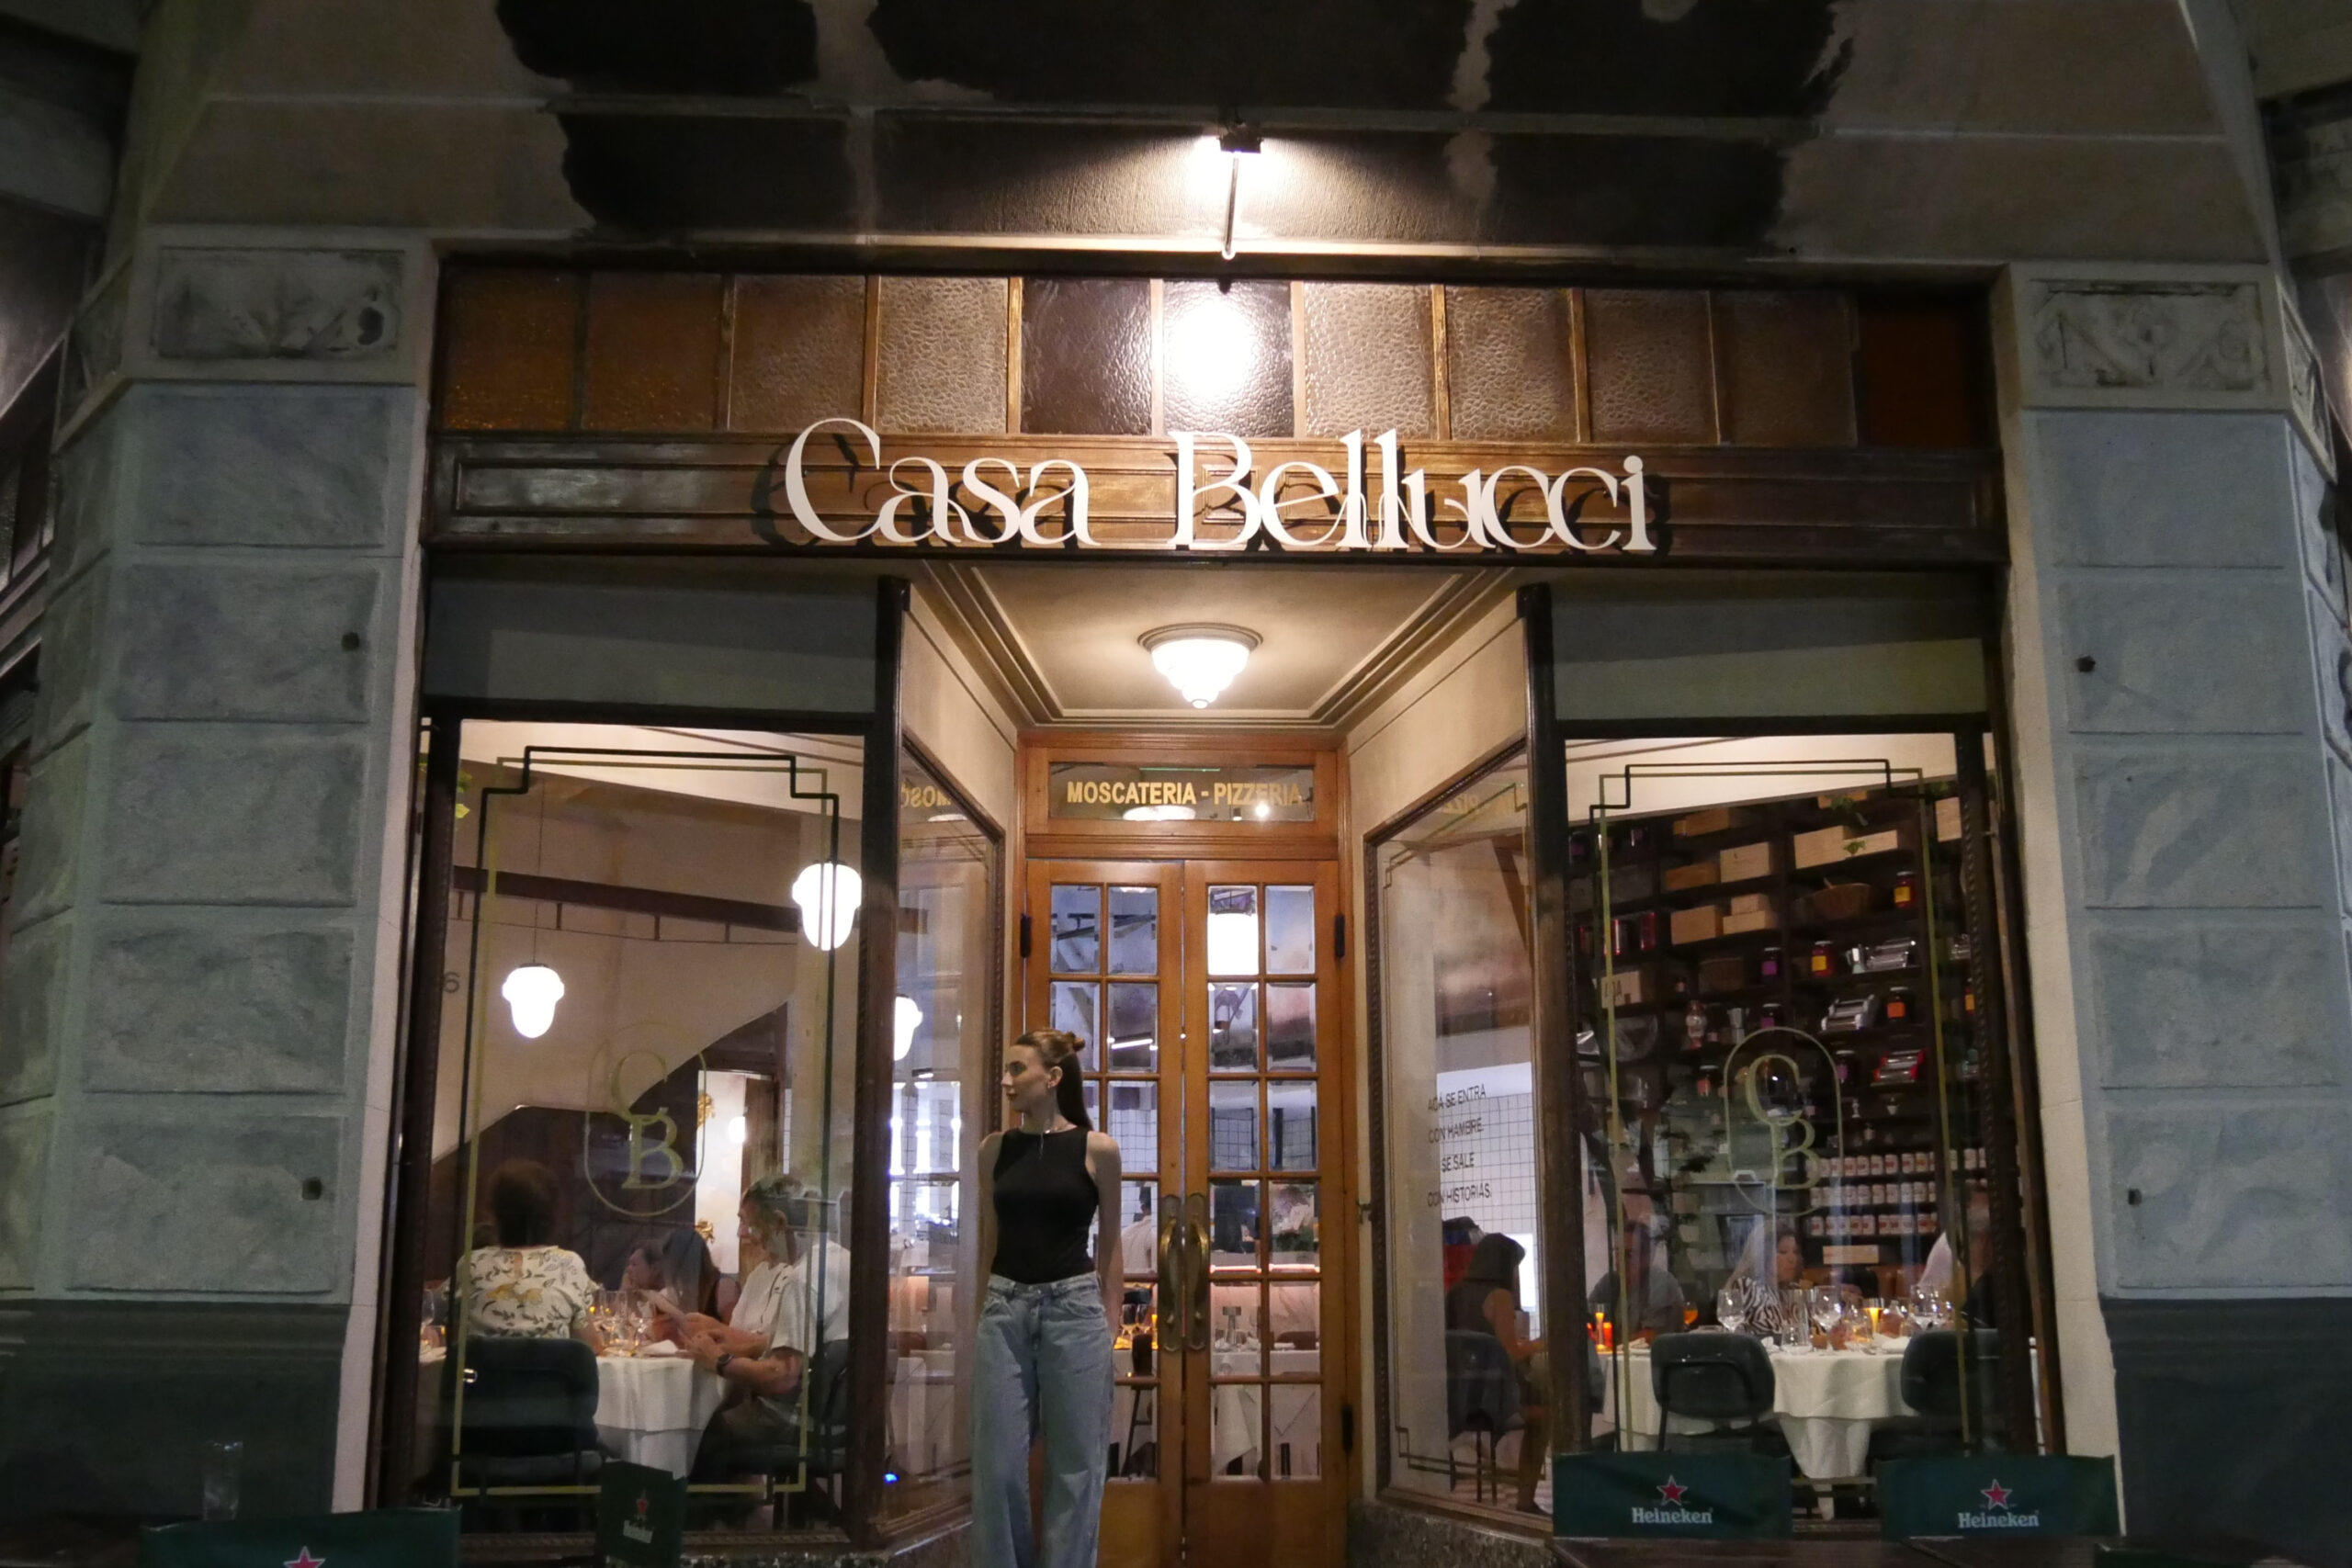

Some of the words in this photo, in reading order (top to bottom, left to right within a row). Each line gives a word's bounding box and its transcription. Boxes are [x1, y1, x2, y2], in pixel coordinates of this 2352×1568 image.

[786, 418, 1102, 547] Casa
[1167, 429, 1657, 551] Bellucci
[1067, 782, 1196, 805] MOSCATERIA
[1215, 783, 1301, 806] PIZZERIA
[1457, 1084, 1487, 1104] ENTRA
[1428, 1127, 1445, 1144] CON
[1442, 1156, 1452, 1172] SE
[1453, 1152, 1475, 1170] SALE
[1631, 1507, 1713, 1524] Heineken
[1958, 1512, 2040, 1529] Heineken
